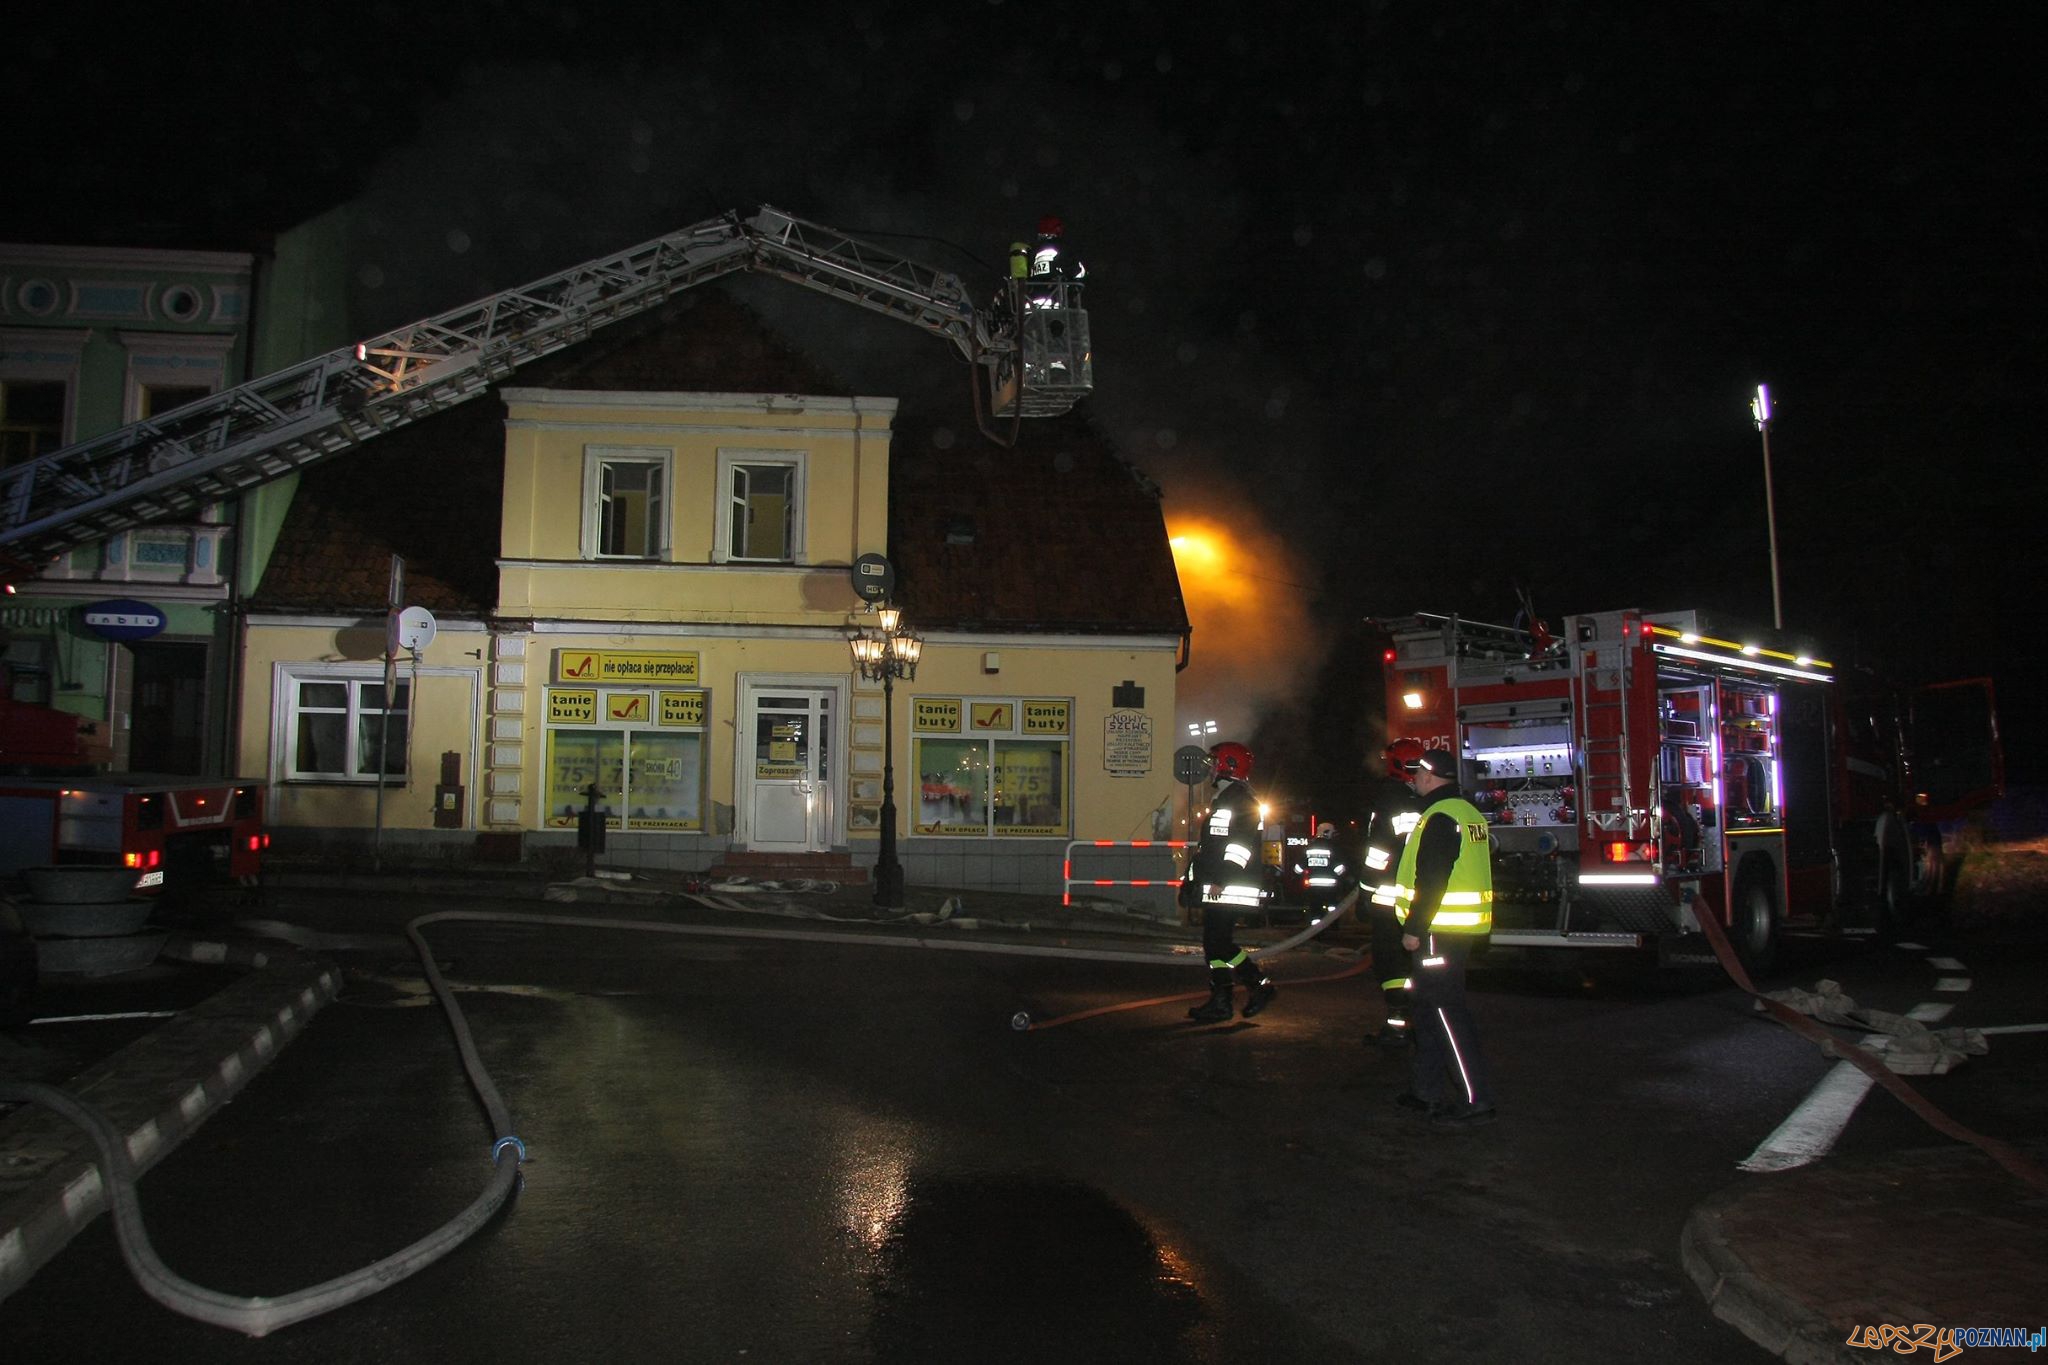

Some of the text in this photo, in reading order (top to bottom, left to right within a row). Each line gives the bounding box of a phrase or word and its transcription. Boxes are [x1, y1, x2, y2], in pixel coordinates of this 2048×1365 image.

[604, 660, 615, 673] nie
[617, 661, 641, 676] opłaca
[655, 661, 694, 677] przepłacać
[552, 695, 591, 705] tanie
[665, 698, 703, 708] tanie
[552, 707, 591, 720] buty
[918, 704, 957, 715] tanie
[1027, 707, 1065, 717] tanie
[665, 710, 703, 722] buty
[1113, 715, 1143, 723] NOWY
[919, 716, 957, 729] buty
[1027, 718, 1065, 731] buty
